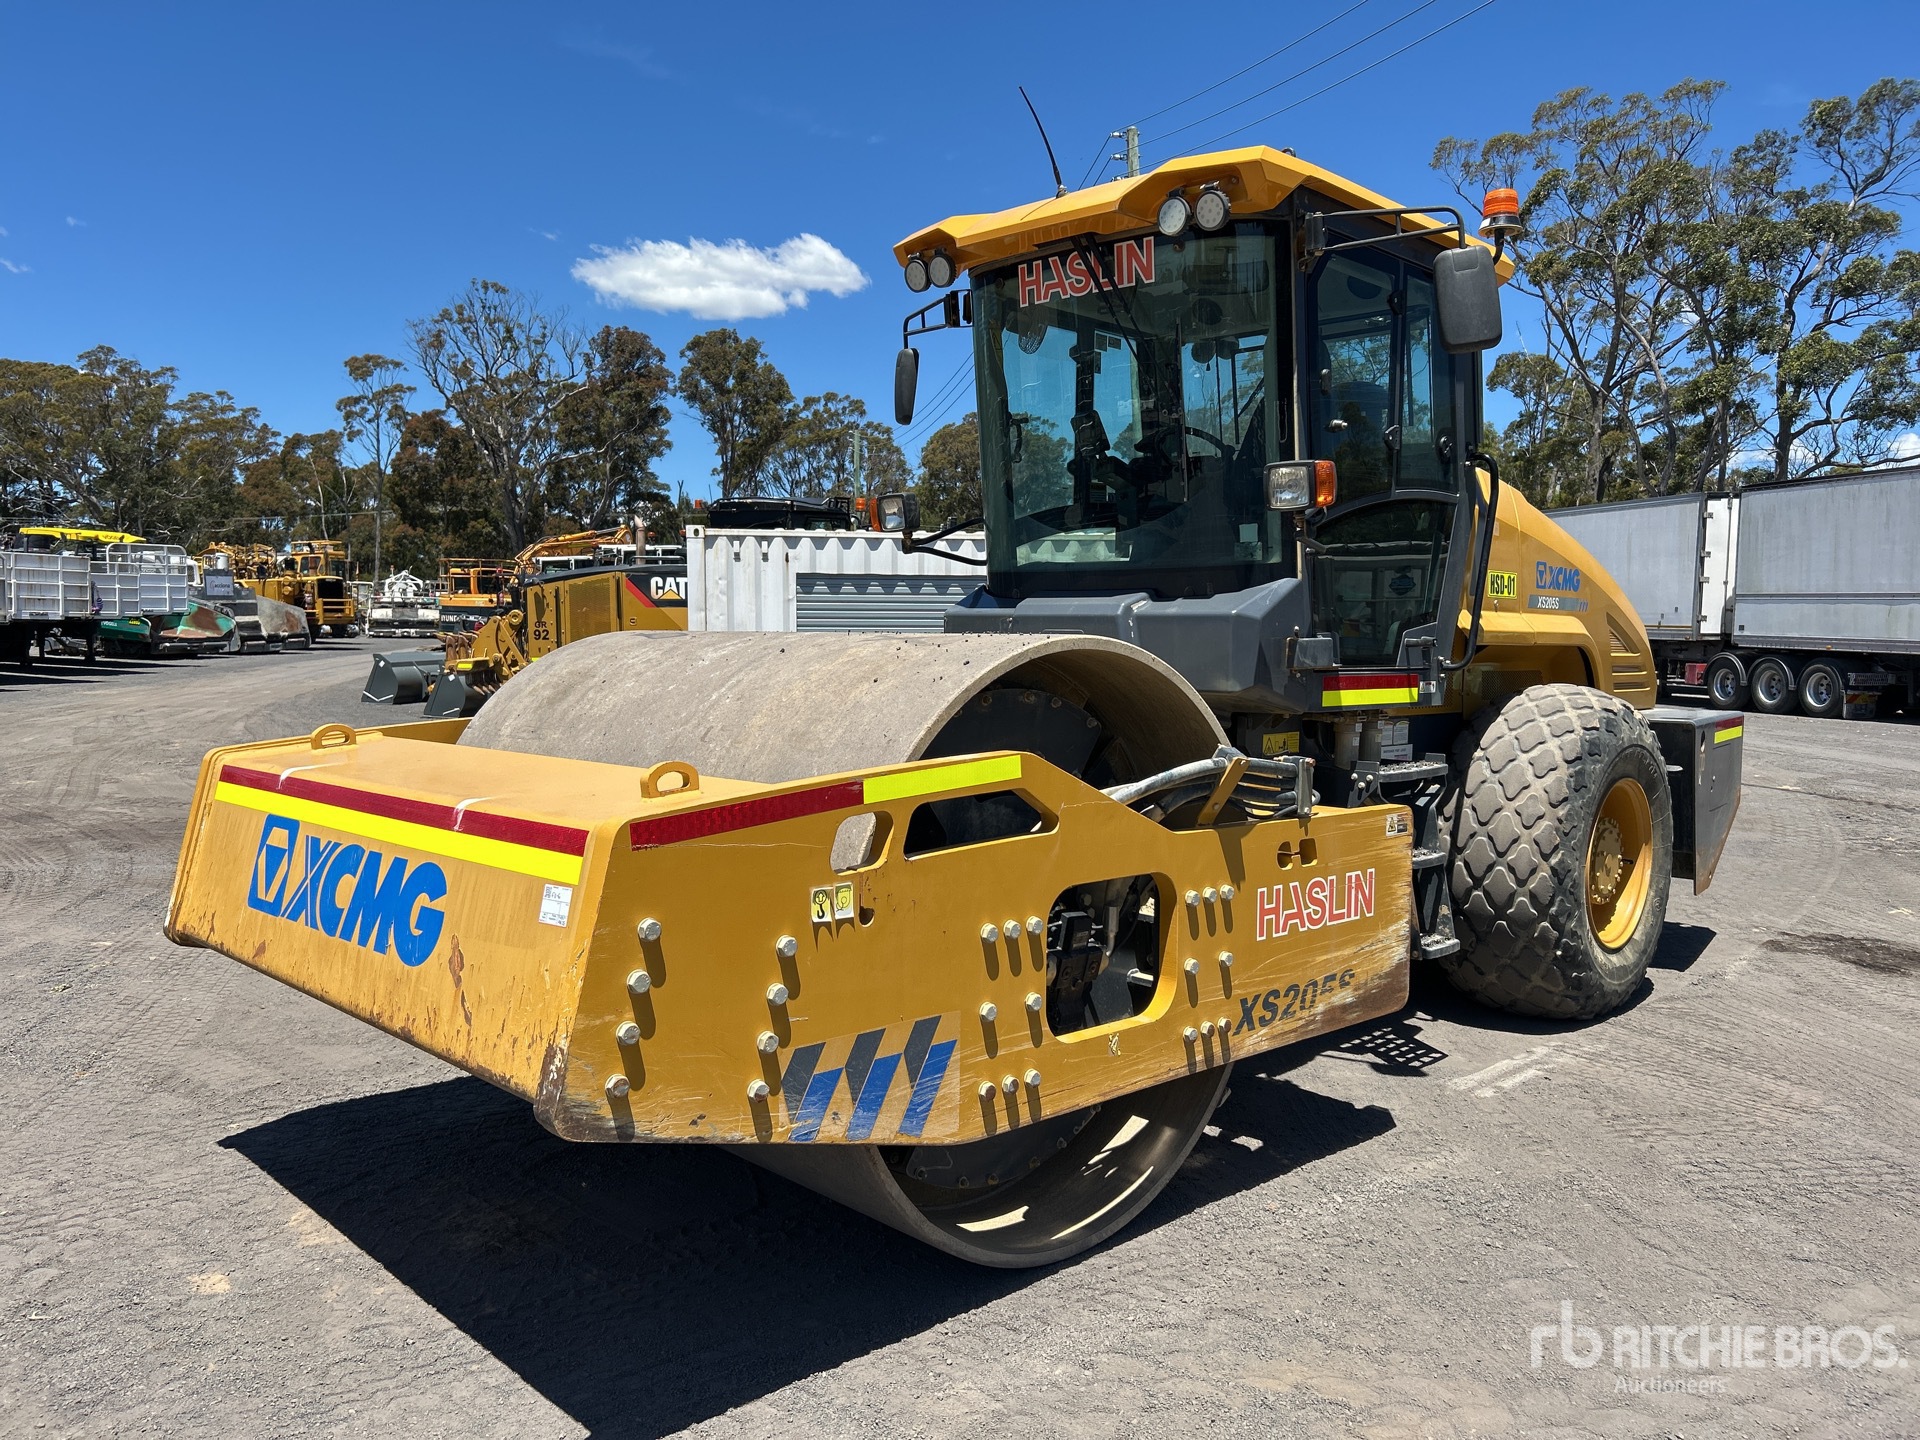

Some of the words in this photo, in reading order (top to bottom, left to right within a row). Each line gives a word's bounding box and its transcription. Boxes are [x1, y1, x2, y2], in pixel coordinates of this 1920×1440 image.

[1018, 236, 1155, 308] HASLIN
[650, 576, 688, 600] CAT
[1490, 574, 1515, 596] HSD-01
[1547, 566, 1580, 592] XCMG
[1537, 596, 1560, 609] XS205S
[533, 629, 550, 641] 92
[534, 620, 548, 629] GR
[280, 834, 448, 968] XCMG
[1256, 867, 1376, 942] HASLIN
